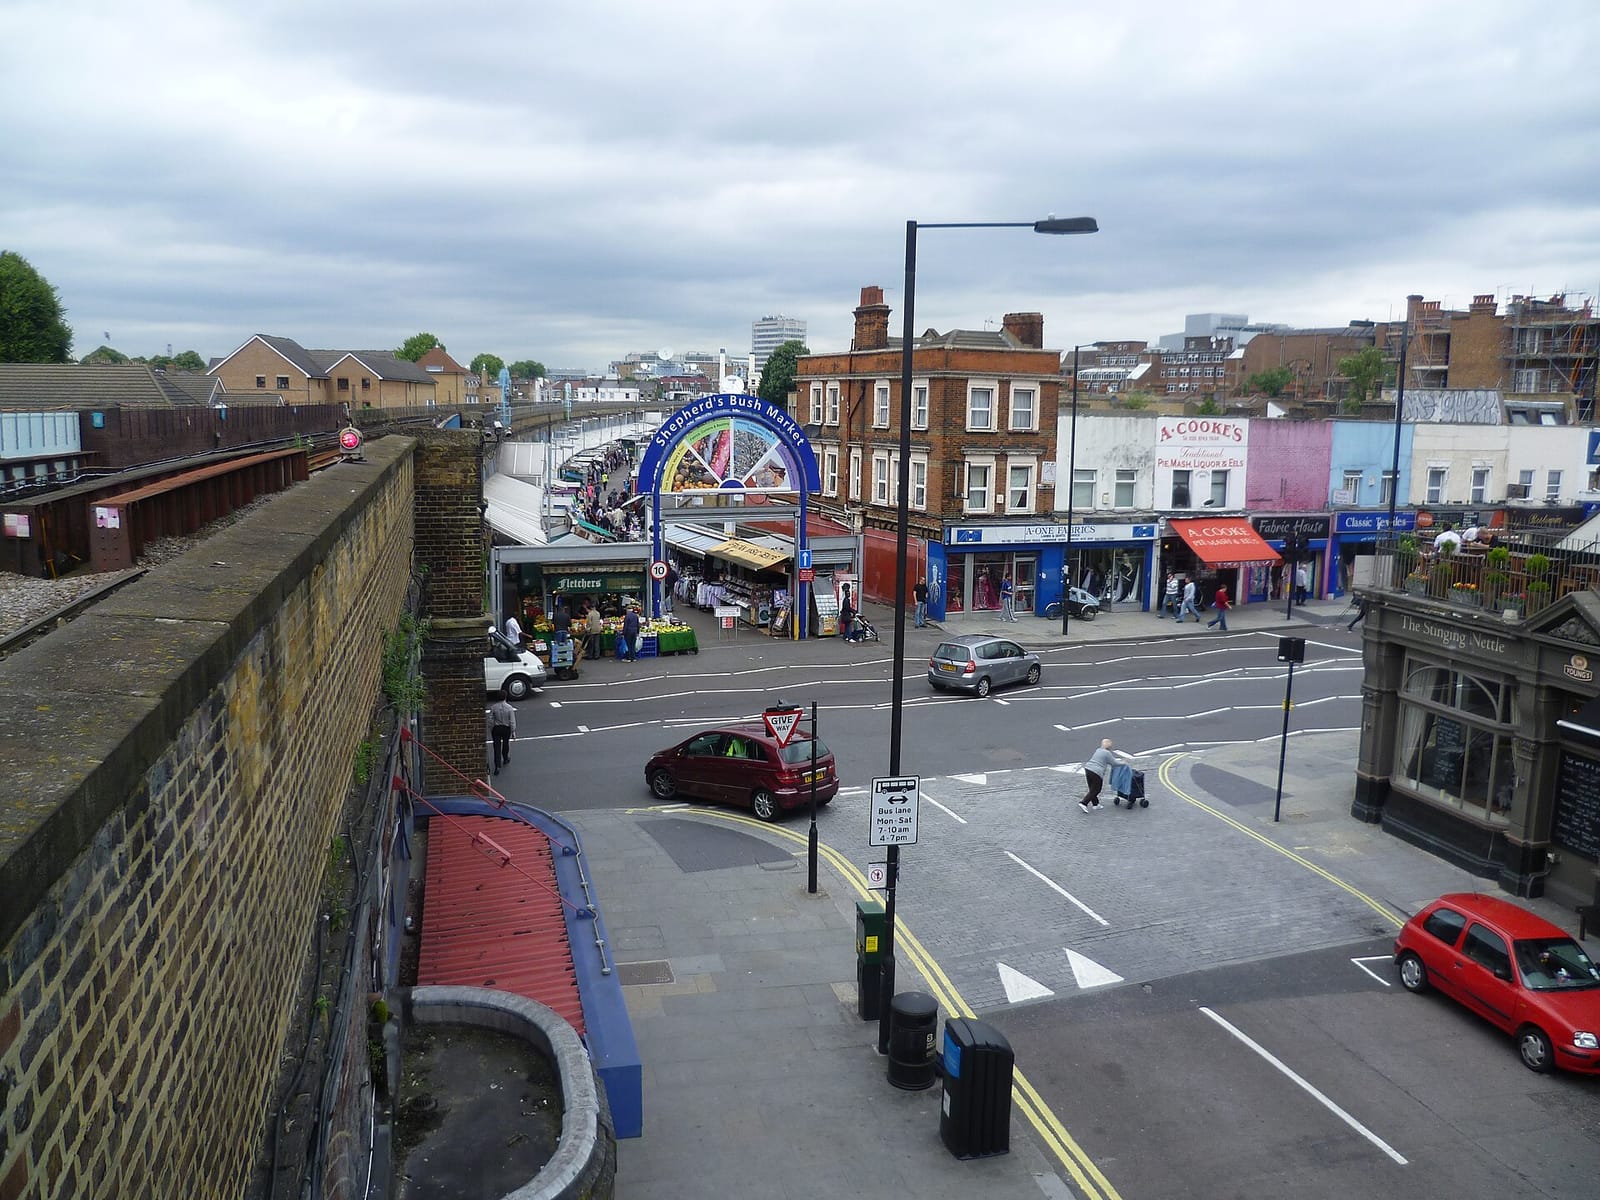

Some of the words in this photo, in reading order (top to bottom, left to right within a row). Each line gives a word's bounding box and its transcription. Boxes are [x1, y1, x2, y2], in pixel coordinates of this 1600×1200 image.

[656, 397, 724, 447] Shepherd's
[730, 395, 762, 411] Bush
[766, 405, 805, 447] Market
[1180, 446, 1225, 458] Traditional
[1194, 459, 1220, 469] LIQUOR
[1229, 458, 1244, 467] EELS
[1259, 519, 1290, 533] Fabric
[1293, 518, 1323, 533] House
[1345, 516, 1372, 527] Classic
[1202, 527, 1251, 537] COOKE
[654, 566, 665, 575] 10
[558, 578, 602, 591] Fletchers
[1400, 615, 1420, 633] The
[1423, 621, 1466, 648] Stinging
[1470, 632, 1505, 653] Nettle
[771, 716, 793, 724] GIVE
